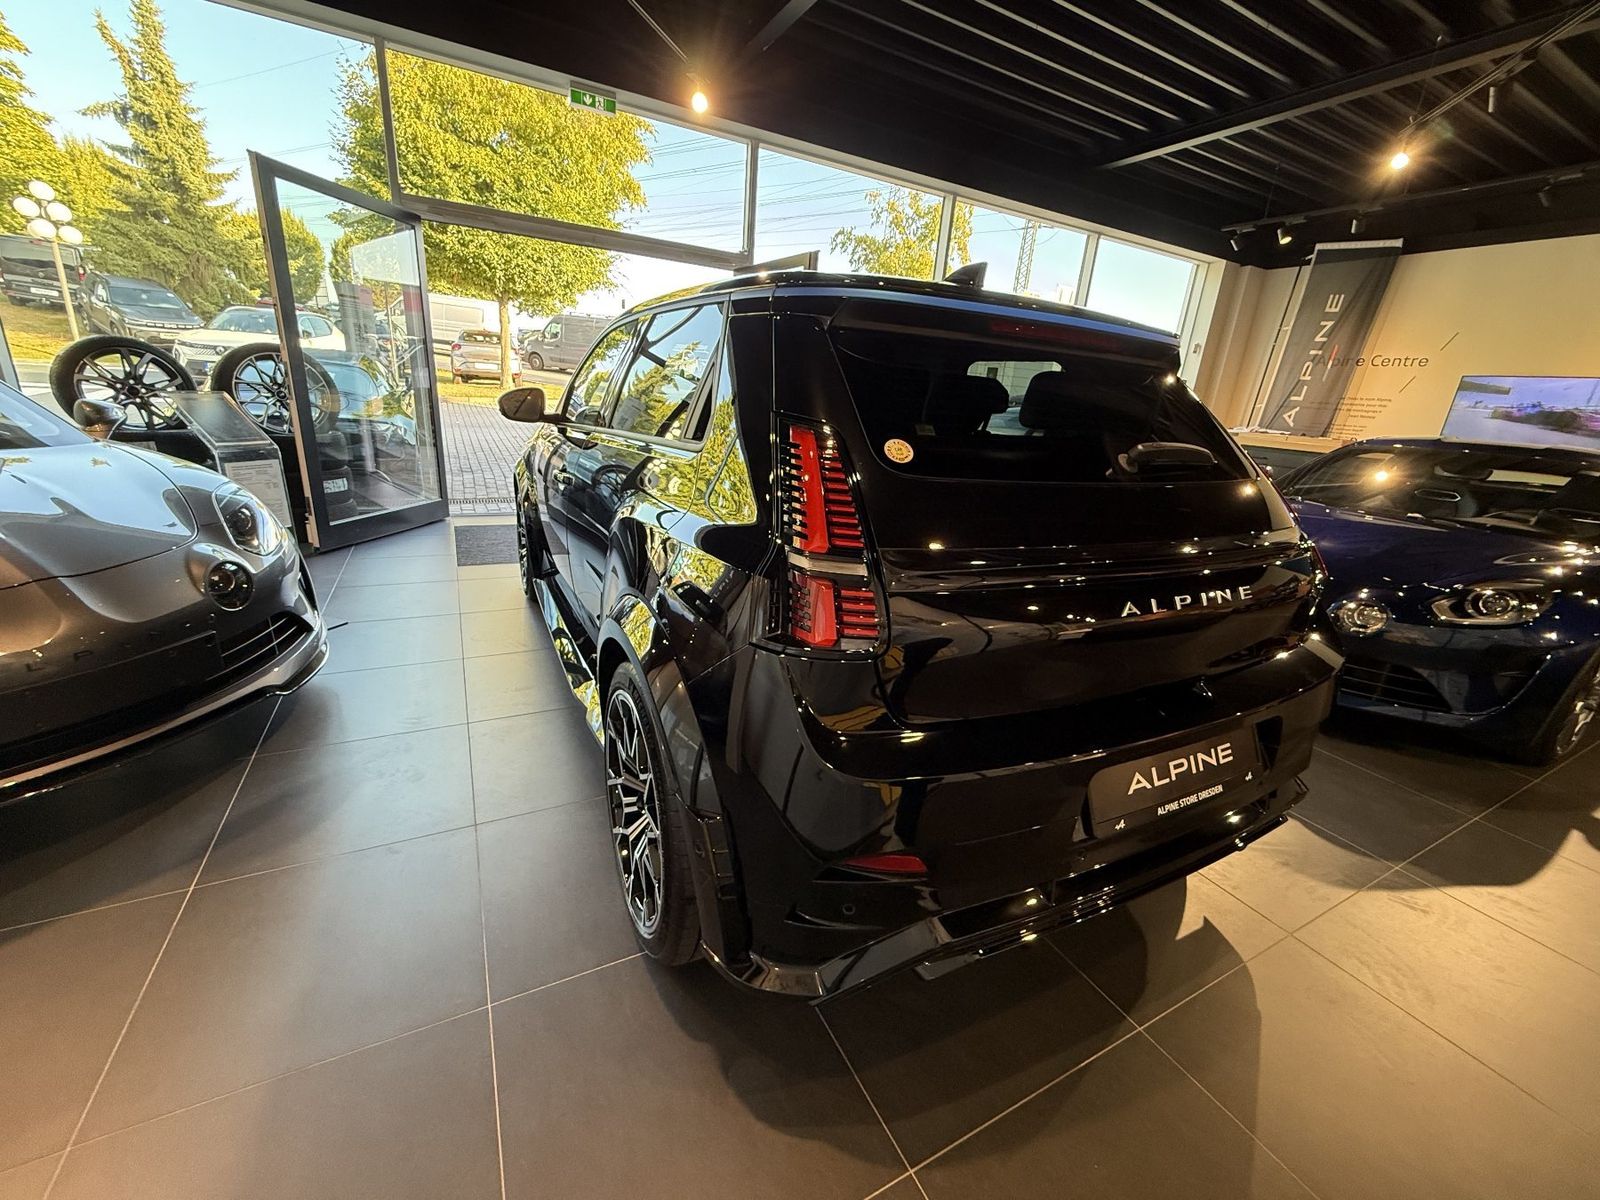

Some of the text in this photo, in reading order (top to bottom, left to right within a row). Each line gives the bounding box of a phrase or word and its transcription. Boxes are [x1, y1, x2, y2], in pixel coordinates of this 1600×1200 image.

[1283, 293, 1345, 427] ALPINE
[1370, 354, 1429, 368] Centre
[1121, 585, 1254, 617] ALPINE
[1127, 742, 1234, 795] ALPINE
[1157, 784, 1224, 816] ALPINE STORE DRESDEN
